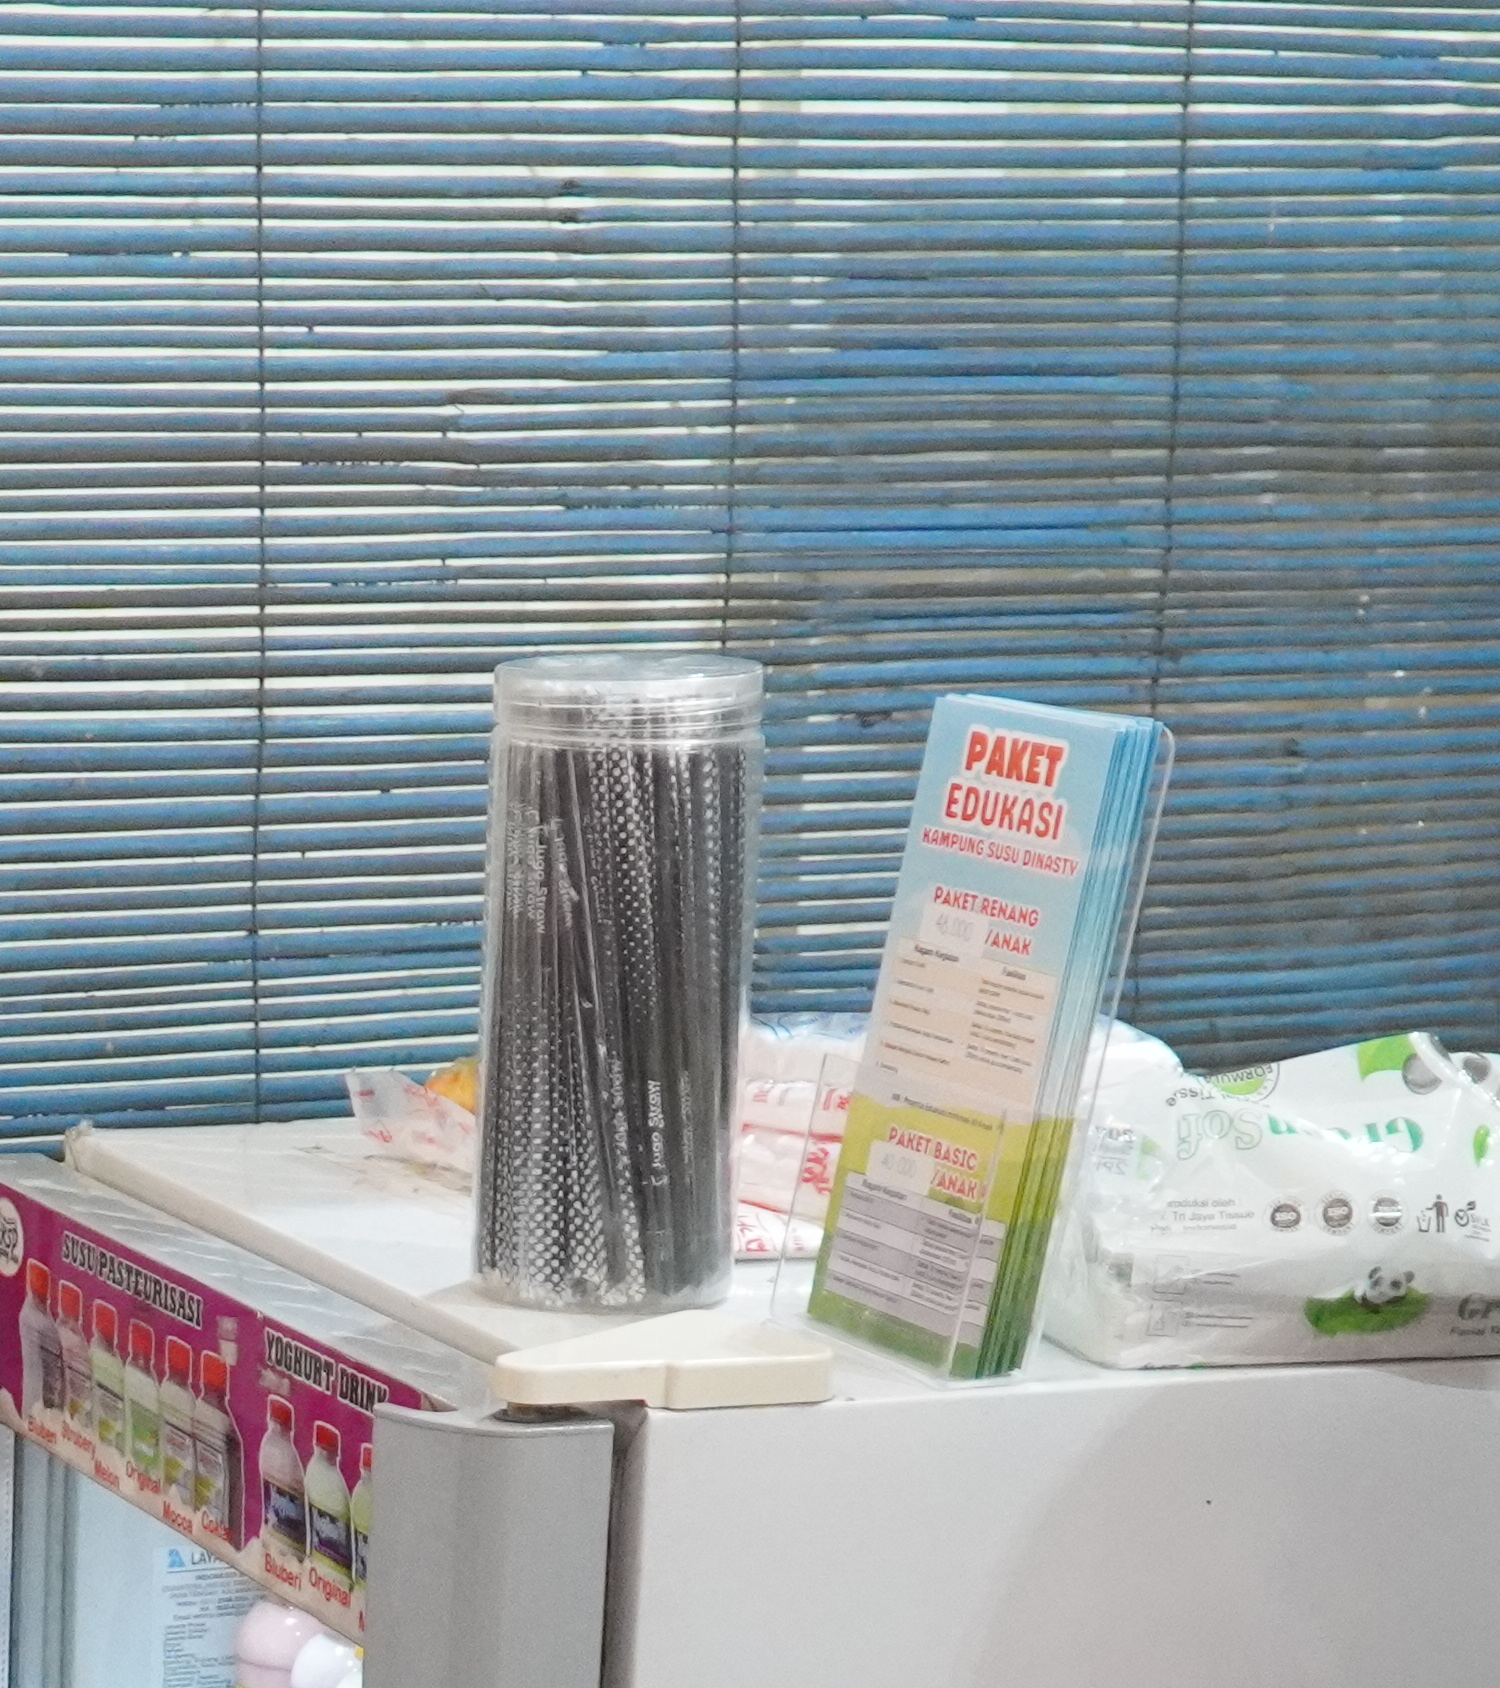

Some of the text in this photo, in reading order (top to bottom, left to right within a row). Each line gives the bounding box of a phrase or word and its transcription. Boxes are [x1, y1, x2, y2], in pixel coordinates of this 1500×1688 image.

[965, 730, 1065, 787] PAKET
[945, 782, 1064, 840] EDUKASI
[922, 827, 1080, 877] KAMPUNG SUSU DINASTY
[933, 886, 1040, 928] PAKET RENANG
[984, 928, 1033, 956] /ANAK
[888, 1126, 978, 1171] PAKET BASIC
[62, 1233, 203, 1329] SUSU PASTEURISASI
[265, 1328, 335, 1393] YOGHURT
[308, 1566, 351, 1606] Original
